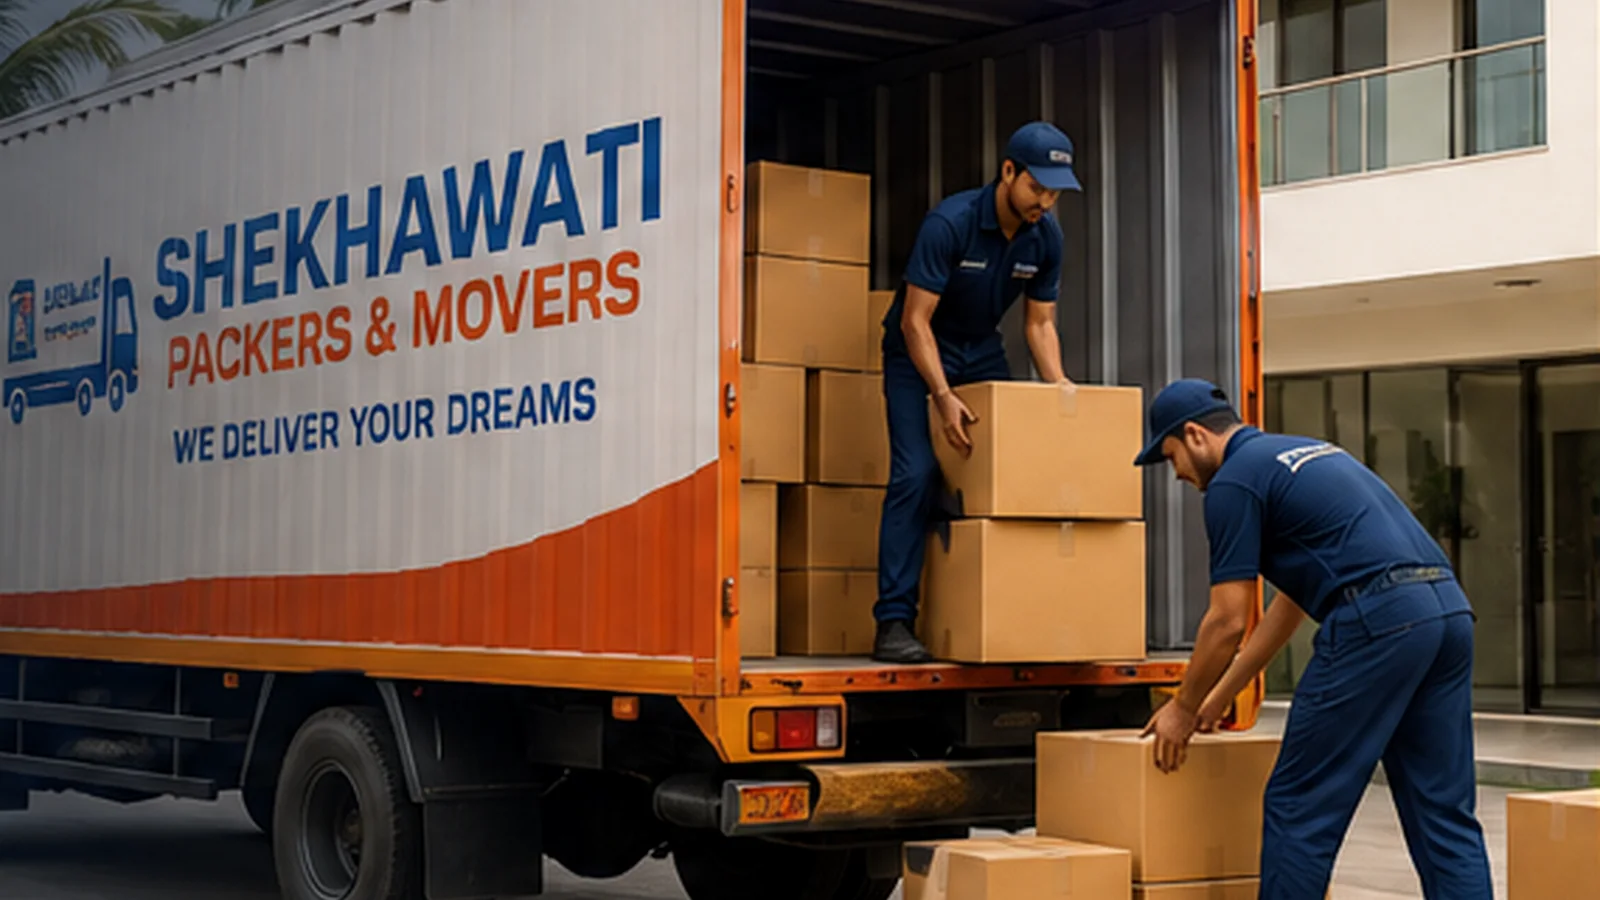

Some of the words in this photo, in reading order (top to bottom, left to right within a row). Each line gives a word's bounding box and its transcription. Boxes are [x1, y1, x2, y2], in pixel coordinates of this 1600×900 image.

[153, 116, 662, 321] SHEKHAWATI
[167, 305, 351, 389] PACKERS
[365, 296, 396, 357] &
[412, 250, 641, 348] MOVERS
[173, 424, 214, 464] WE
[222, 410, 339, 456] DELIVER
[349, 396, 434, 448] YOUR
[447, 377, 596, 435] DREAMS
